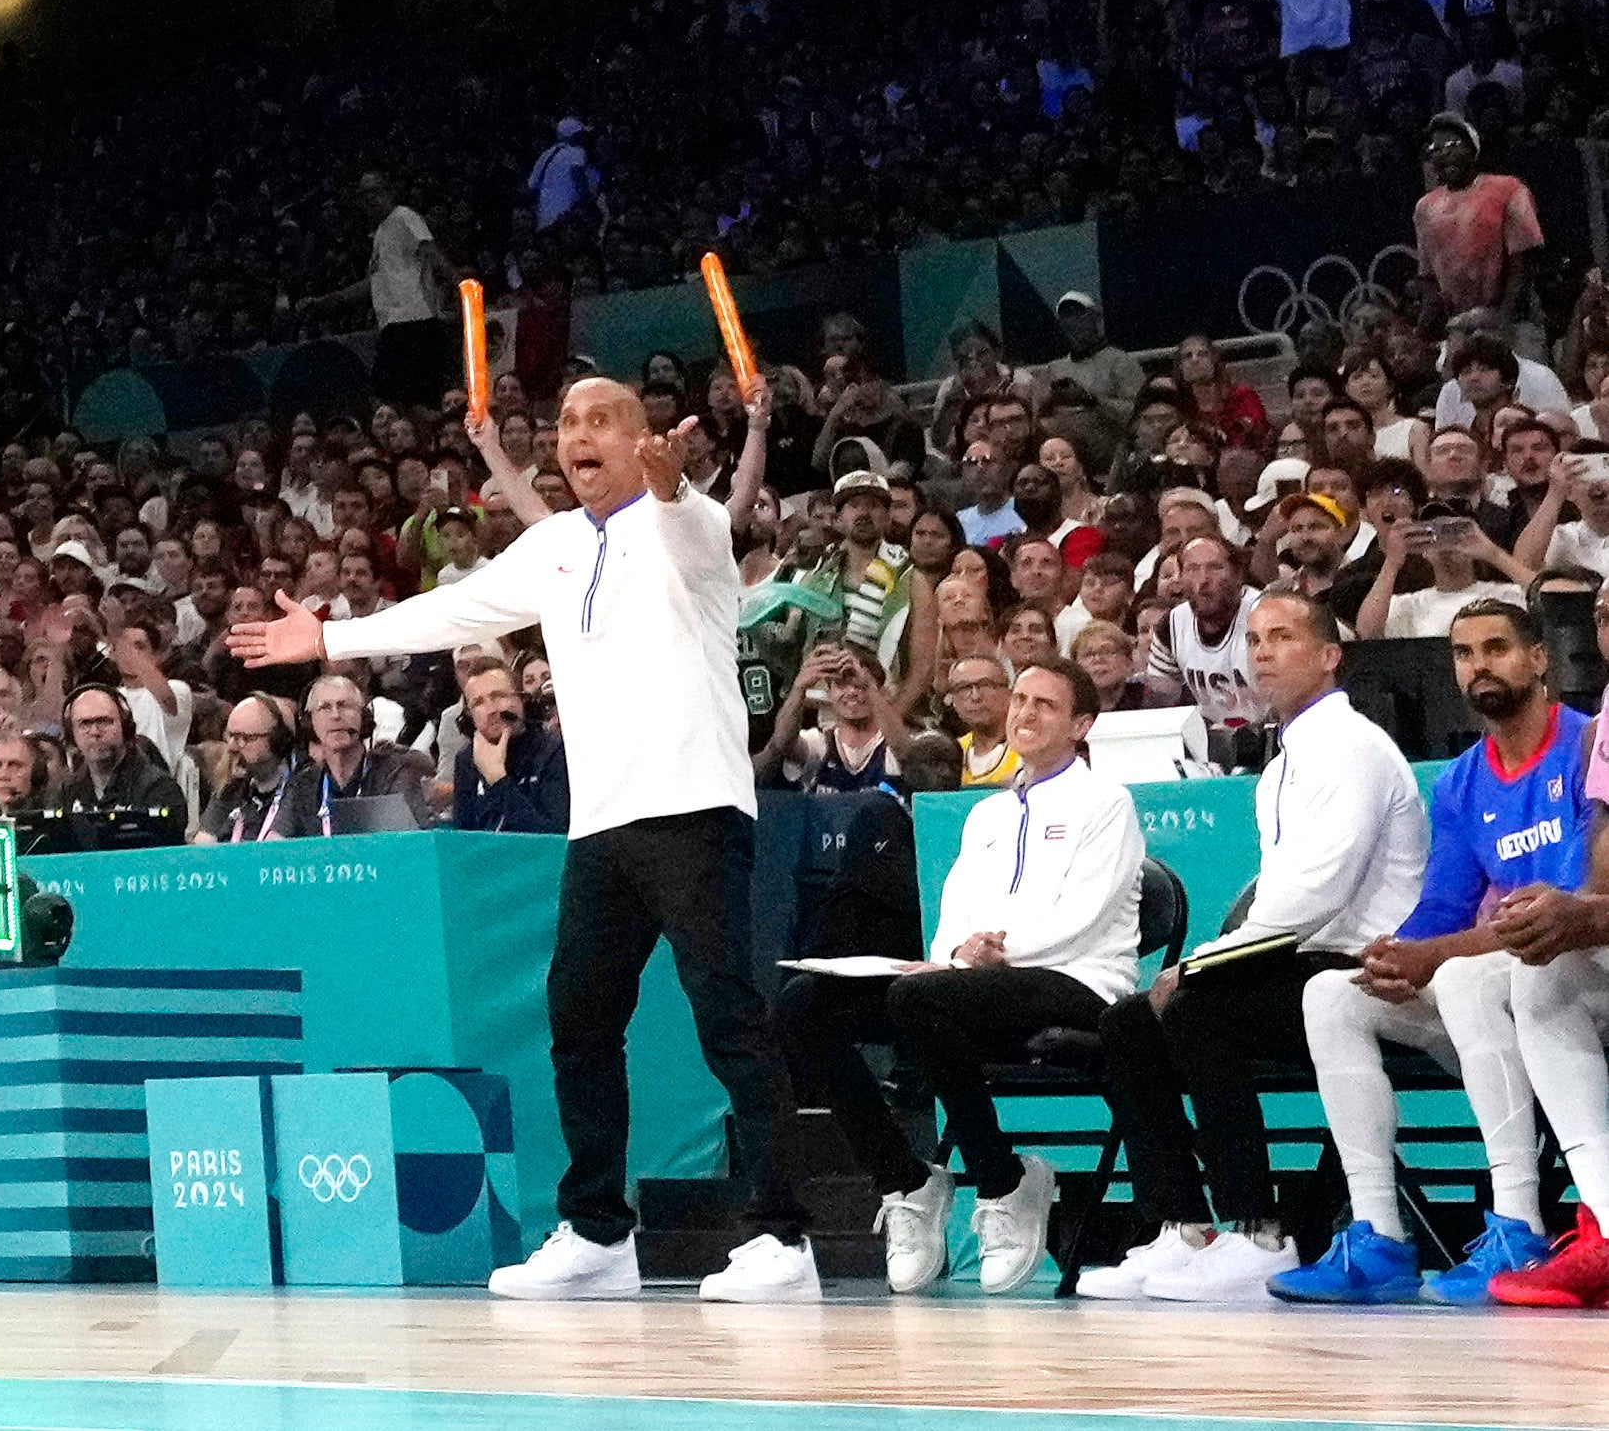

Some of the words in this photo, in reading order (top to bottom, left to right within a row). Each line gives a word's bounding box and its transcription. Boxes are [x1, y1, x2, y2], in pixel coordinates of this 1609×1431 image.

[1144, 807, 1215, 832] 2024
[114, 872, 169, 895] PARIS
[176, 872, 229, 891] 2024
[259, 866, 316, 885] PARIS
[323, 863, 377, 884] 2024
[170, 1149, 242, 1177] PARIS
[173, 1181, 245, 1208] 2024
